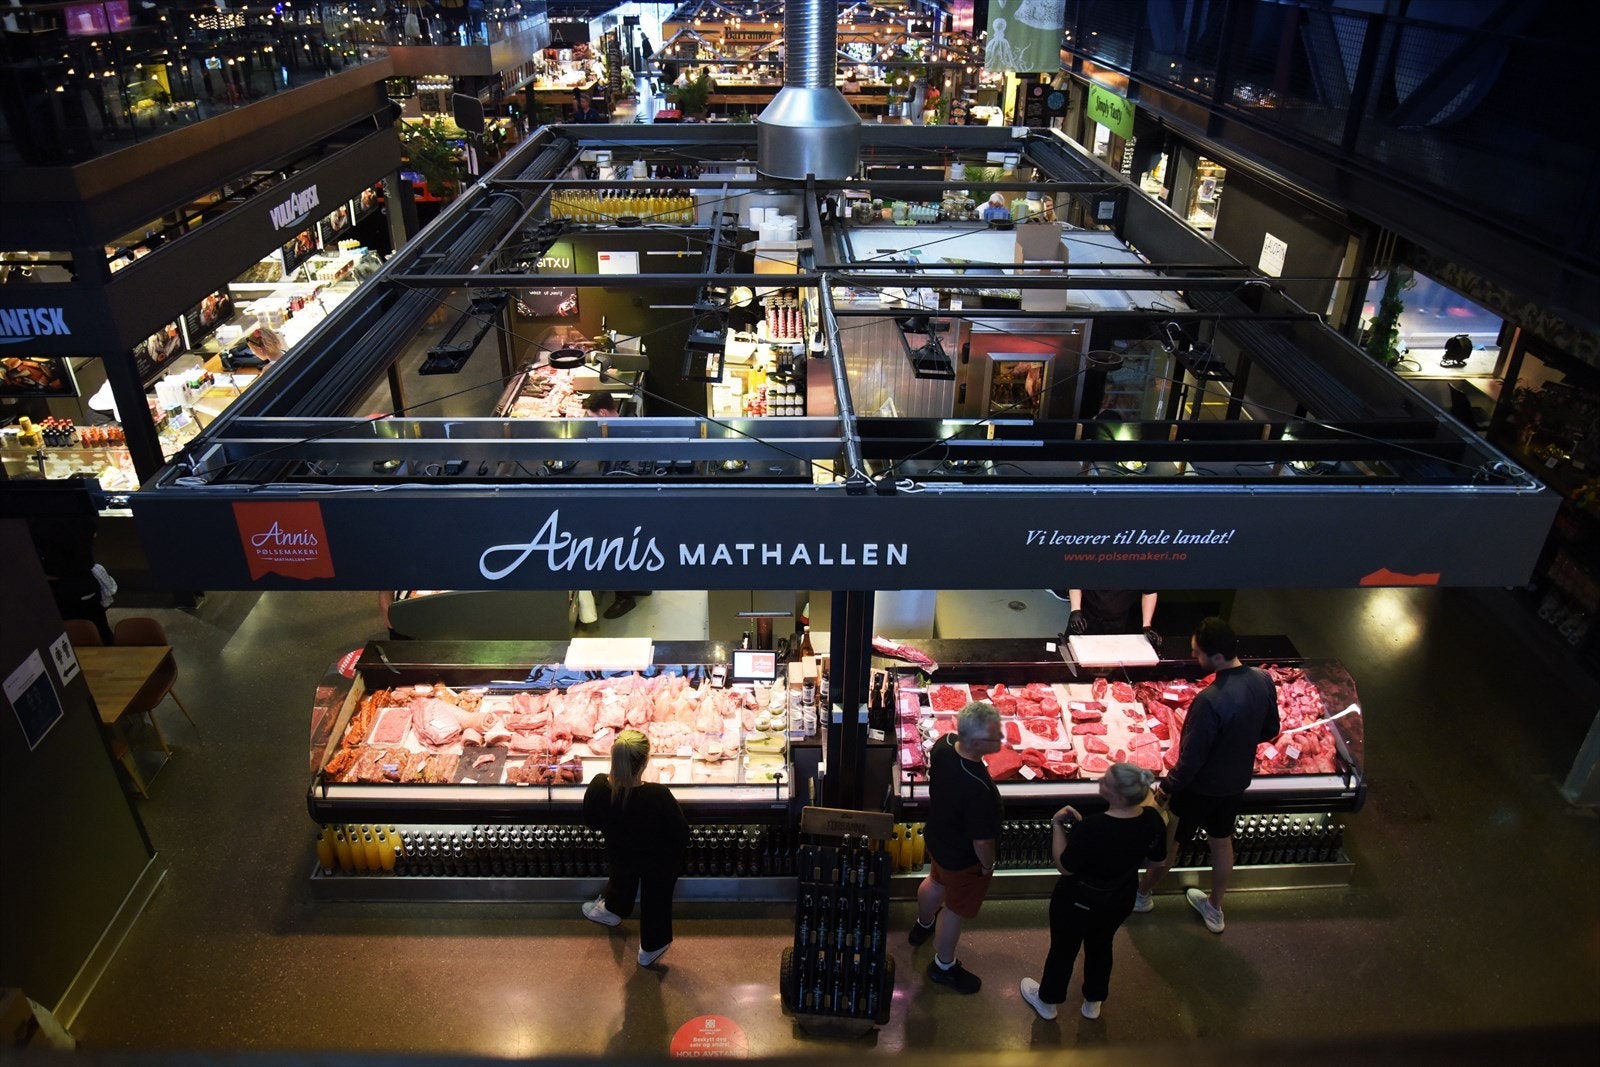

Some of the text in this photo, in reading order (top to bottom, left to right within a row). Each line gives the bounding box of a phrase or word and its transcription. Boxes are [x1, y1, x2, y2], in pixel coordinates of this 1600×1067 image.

[251, 521, 319, 547] Annis
[478, 508, 909, 581] Annis MATHALLEN
[1025, 529, 1236, 545] Vi leverer til hele landet!
[1063, 551, 1188, 563] www.polsemakeri.no
